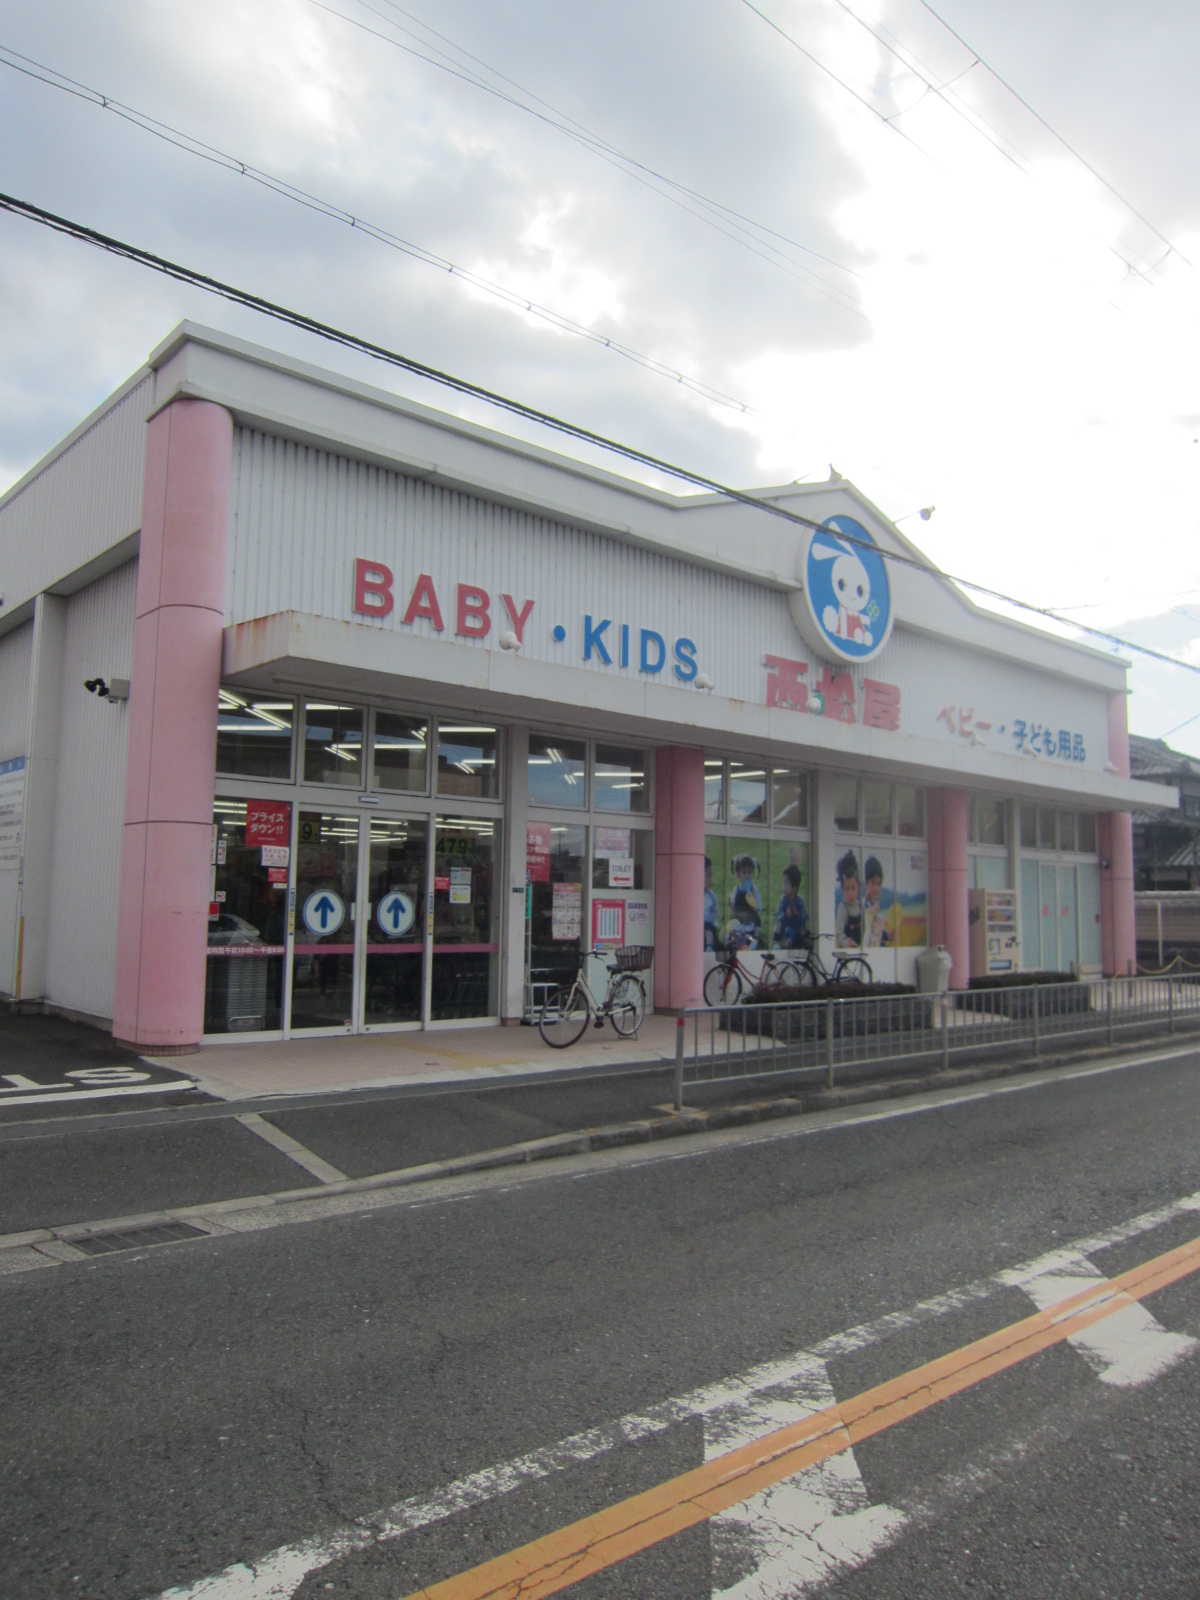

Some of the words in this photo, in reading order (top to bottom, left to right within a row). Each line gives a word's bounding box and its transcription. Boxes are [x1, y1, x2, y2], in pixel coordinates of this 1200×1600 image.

[763, 654, 902, 731] 西松屋
[251, 811, 284, 823] プライス
[612, 864, 631, 873] TOILET
